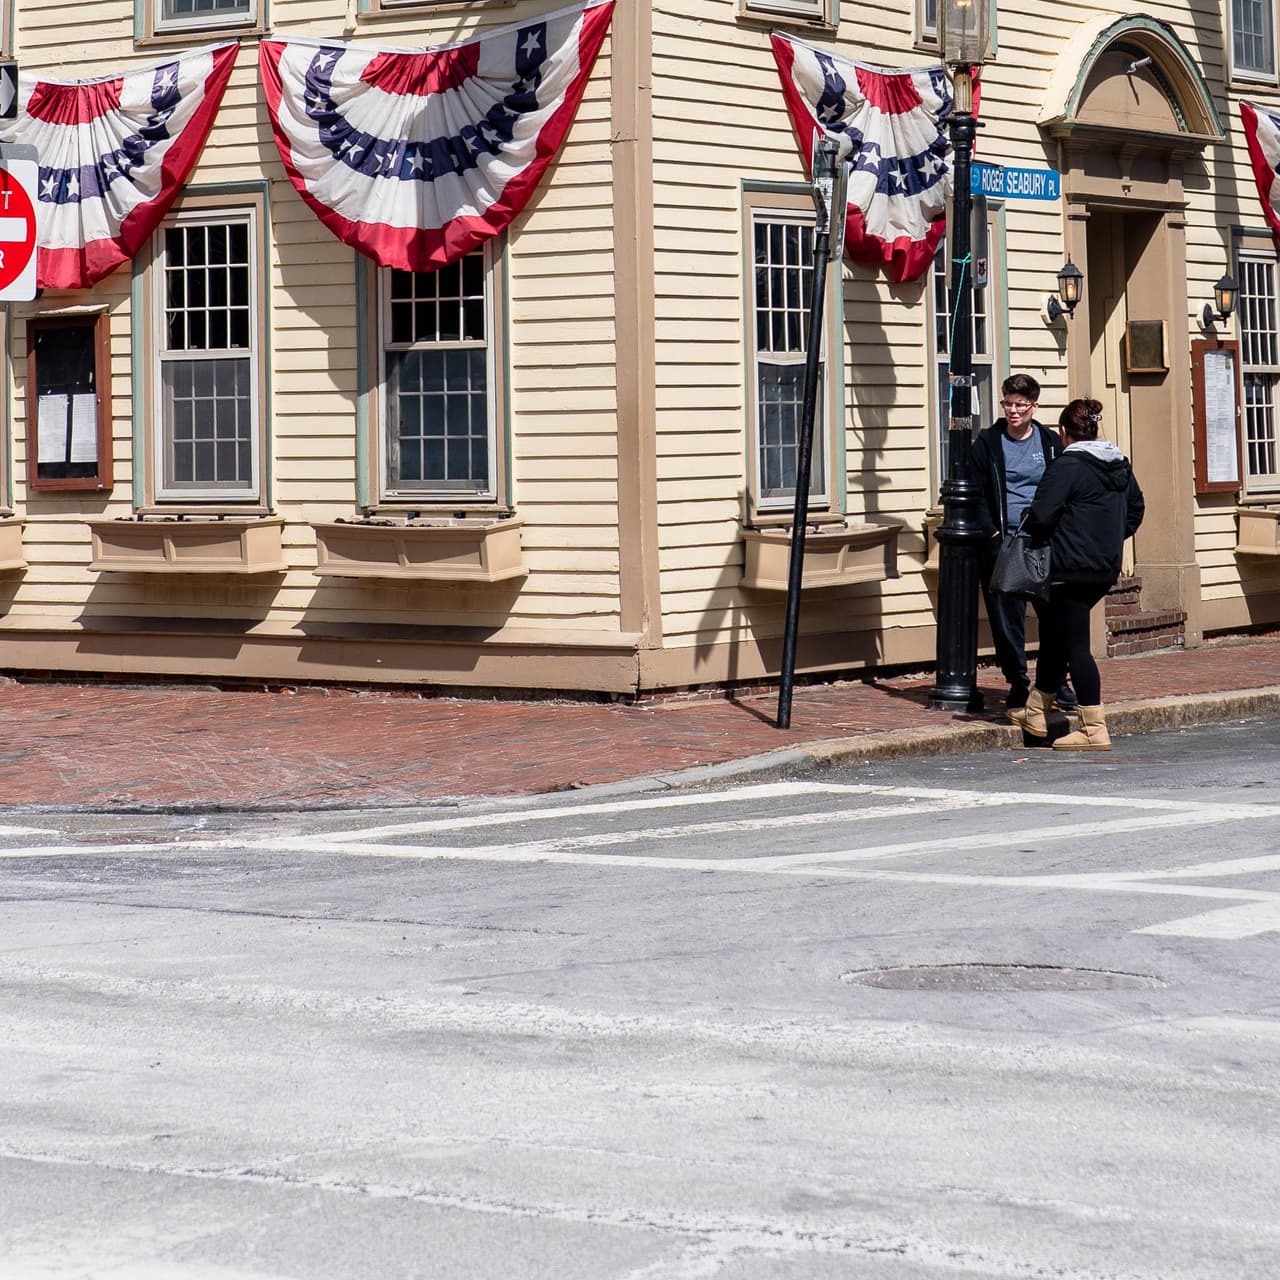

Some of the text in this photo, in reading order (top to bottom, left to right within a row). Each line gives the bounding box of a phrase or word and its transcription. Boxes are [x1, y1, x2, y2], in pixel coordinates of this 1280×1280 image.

[982, 168, 1056, 196] ROGER SEABURY PL
